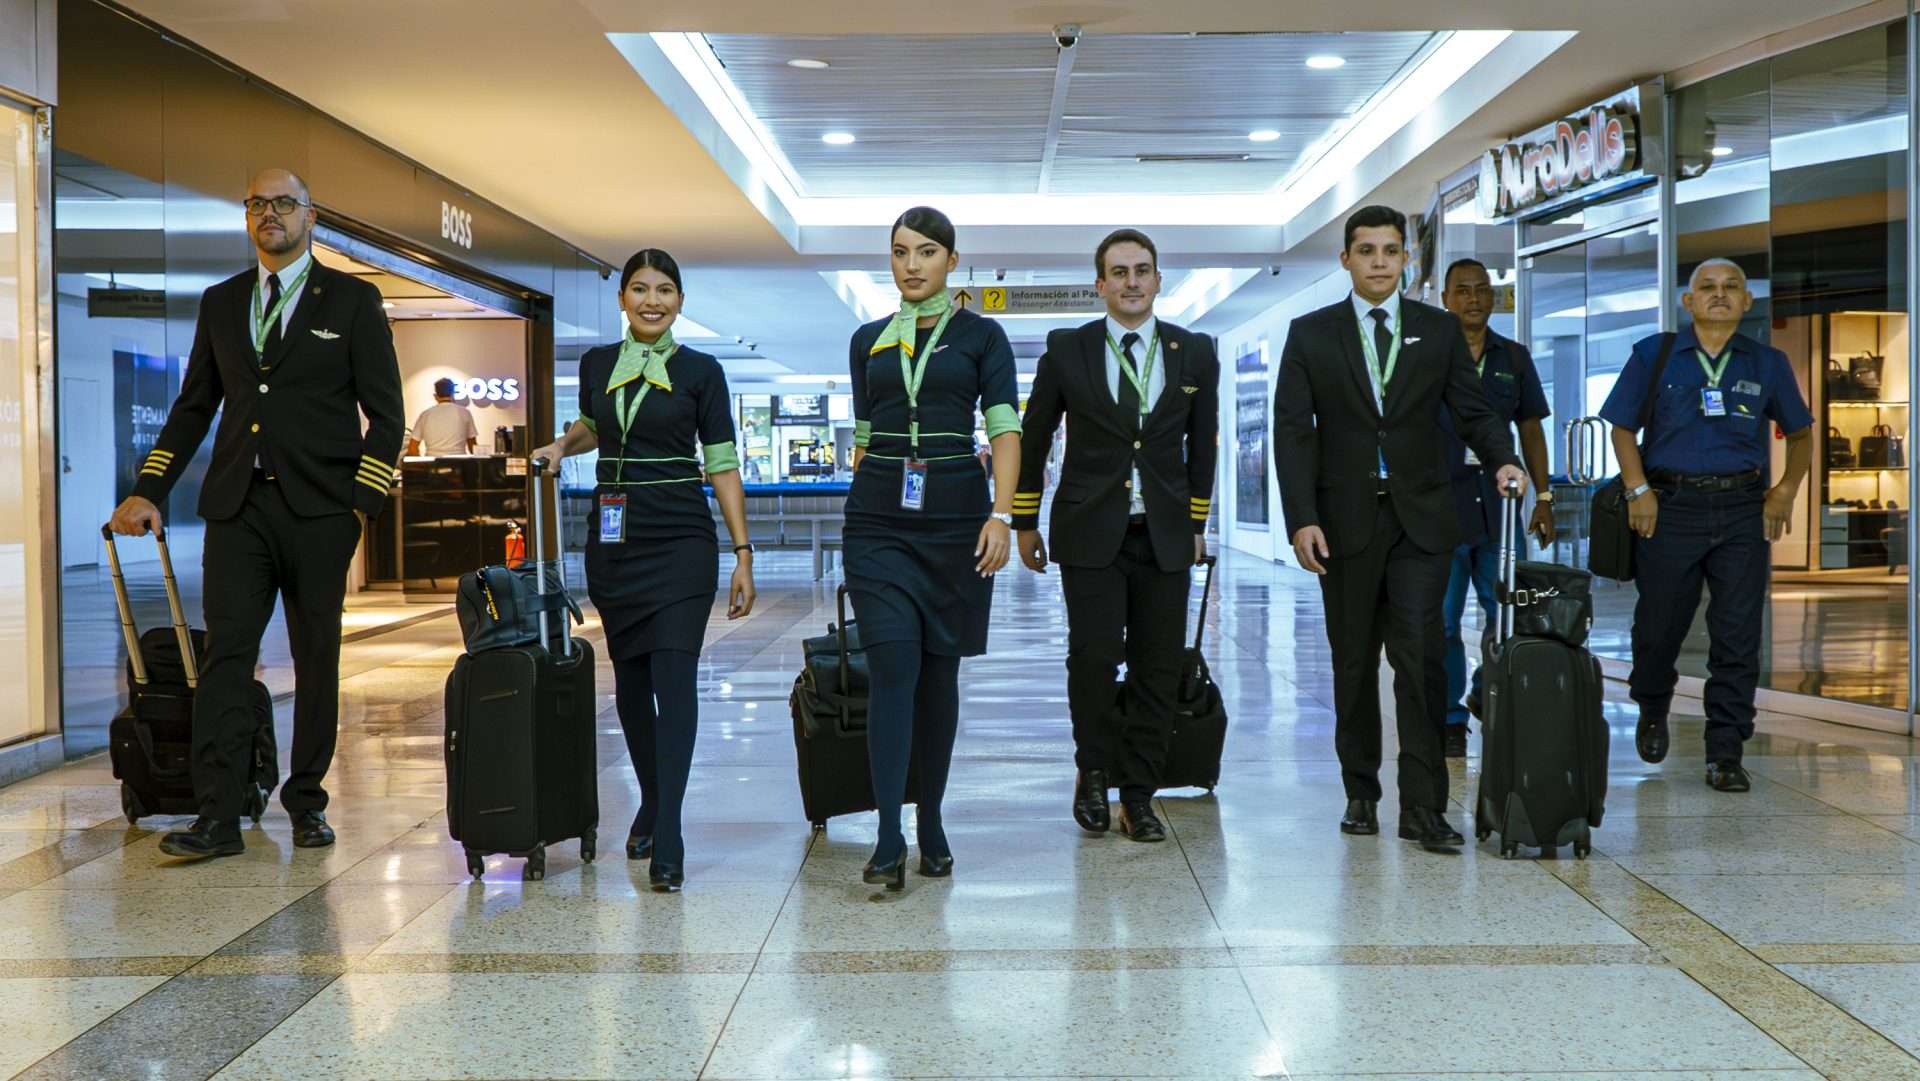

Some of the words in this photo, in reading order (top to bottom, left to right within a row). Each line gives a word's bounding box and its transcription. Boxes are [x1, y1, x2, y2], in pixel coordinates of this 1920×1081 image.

[441, 200, 472, 249] BOSS
[1011, 289, 1068, 299] Información
[1071, 289, 1080, 298] al
[451, 377, 519, 400] BOSS
